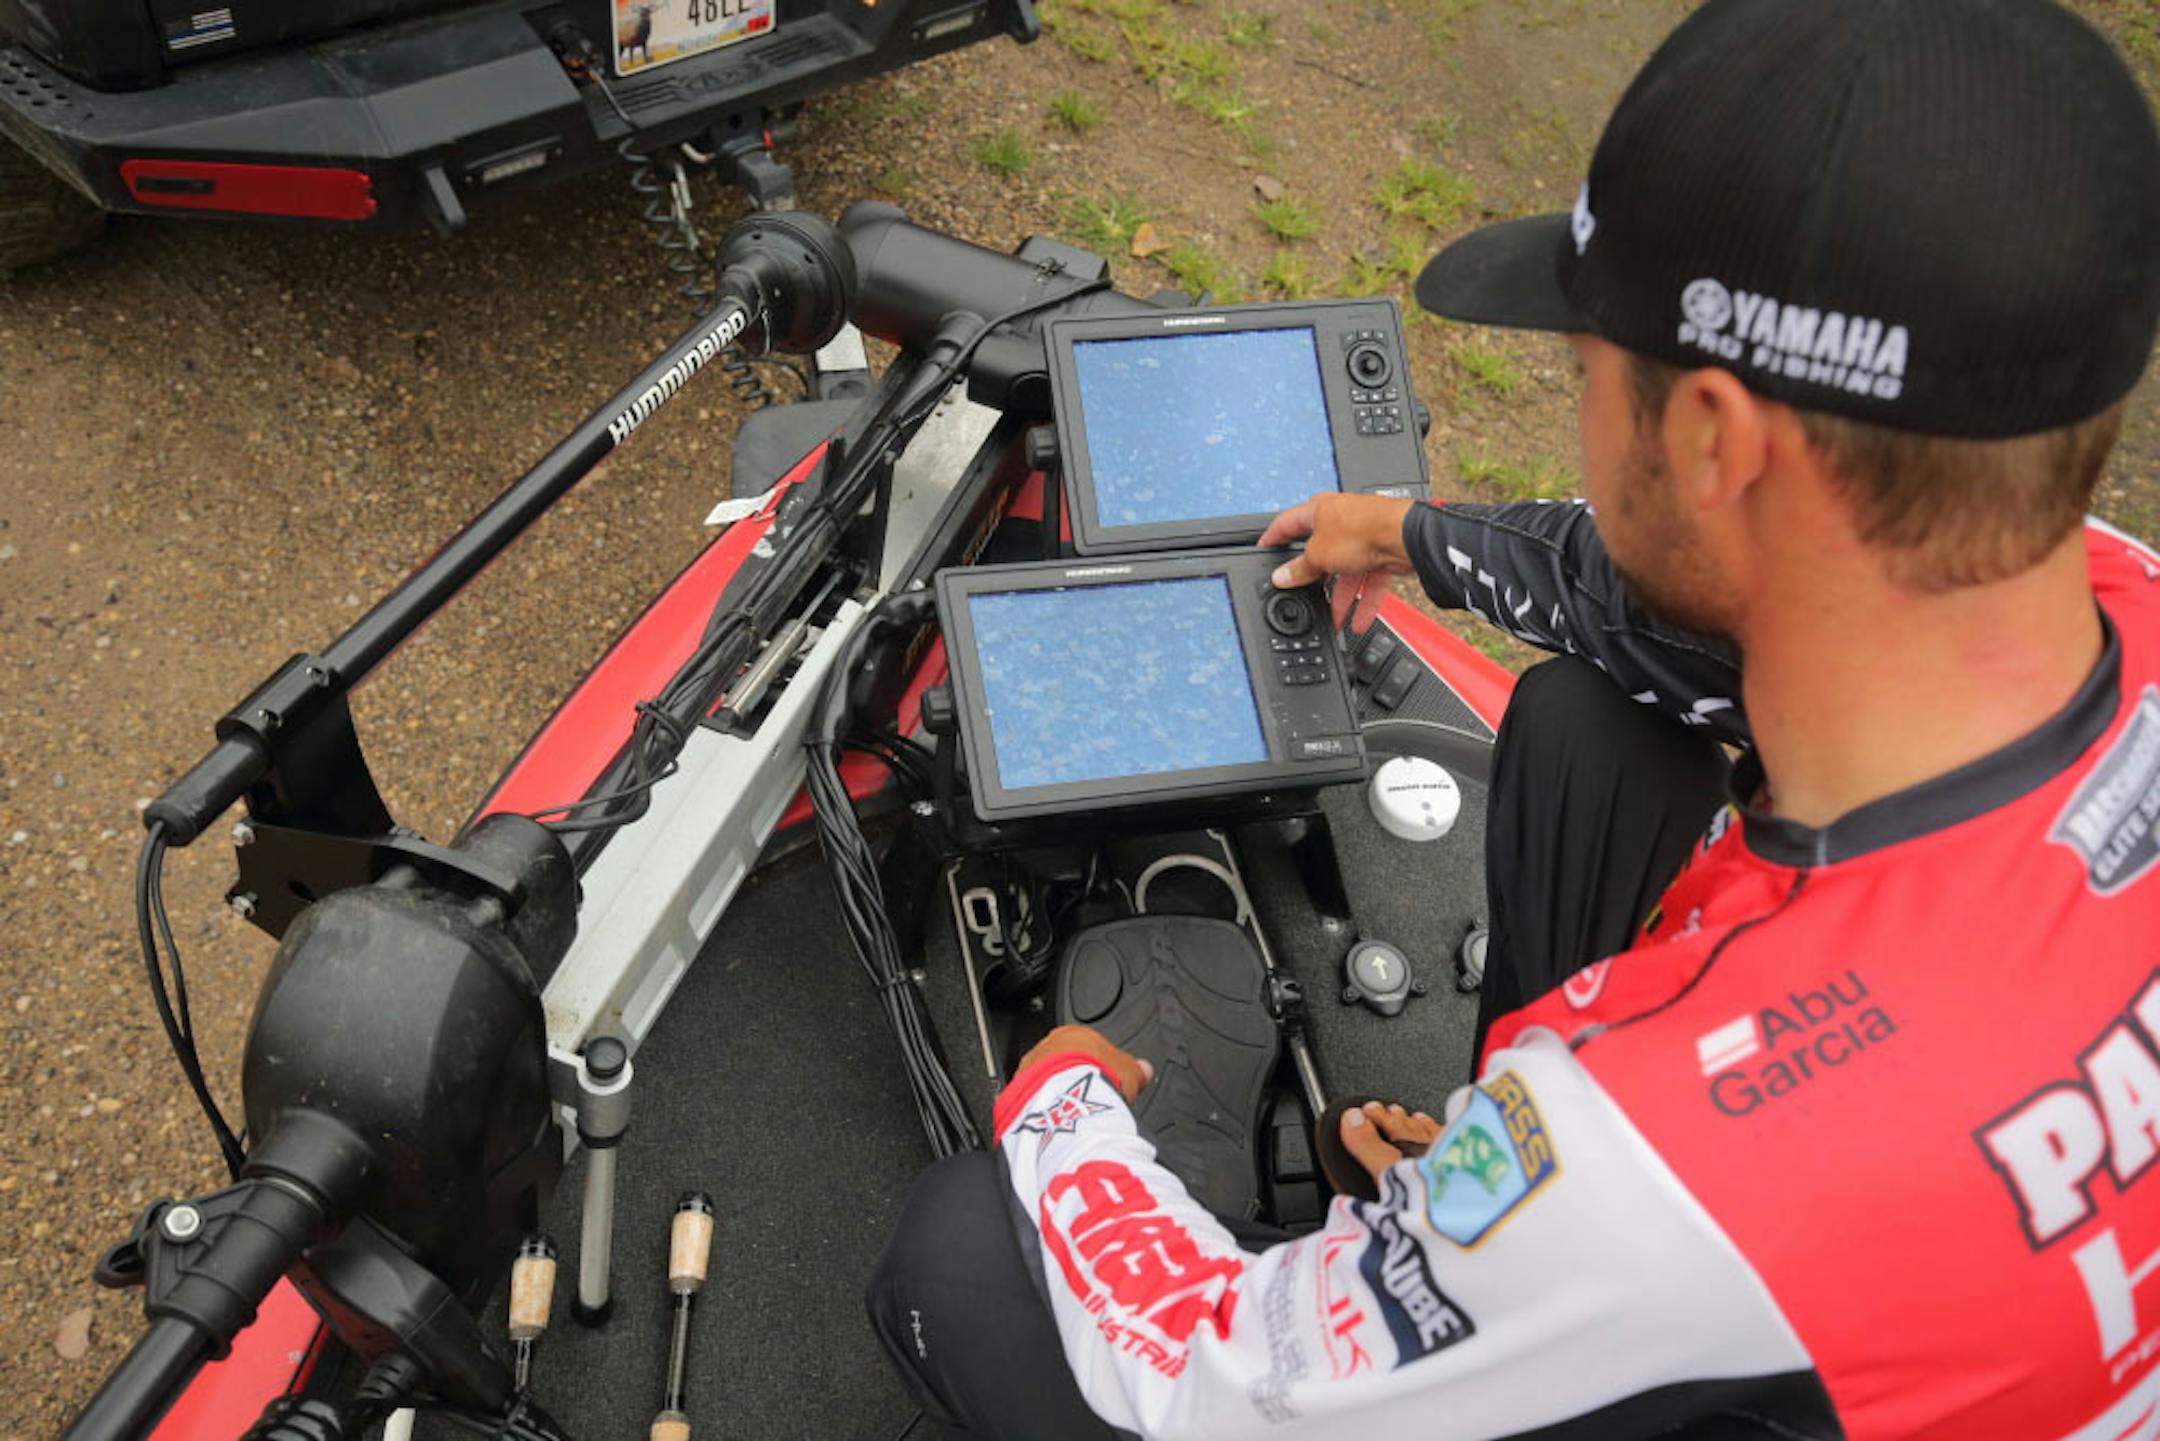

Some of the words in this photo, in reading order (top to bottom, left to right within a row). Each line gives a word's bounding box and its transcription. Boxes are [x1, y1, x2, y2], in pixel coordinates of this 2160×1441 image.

[1677, 321, 1744, 360] PRO
[1751, 344, 1903, 400] FISHING
[1732, 289, 1909, 377] YAMAHA
[607, 309, 747, 446] HUMMINBIRD
[2094, 807, 2149, 881] ELITE
[1759, 969, 1869, 1050] Abu
[1708, 1005, 1896, 1118] Garcia
[1971, 965, 2160, 1254] PA
